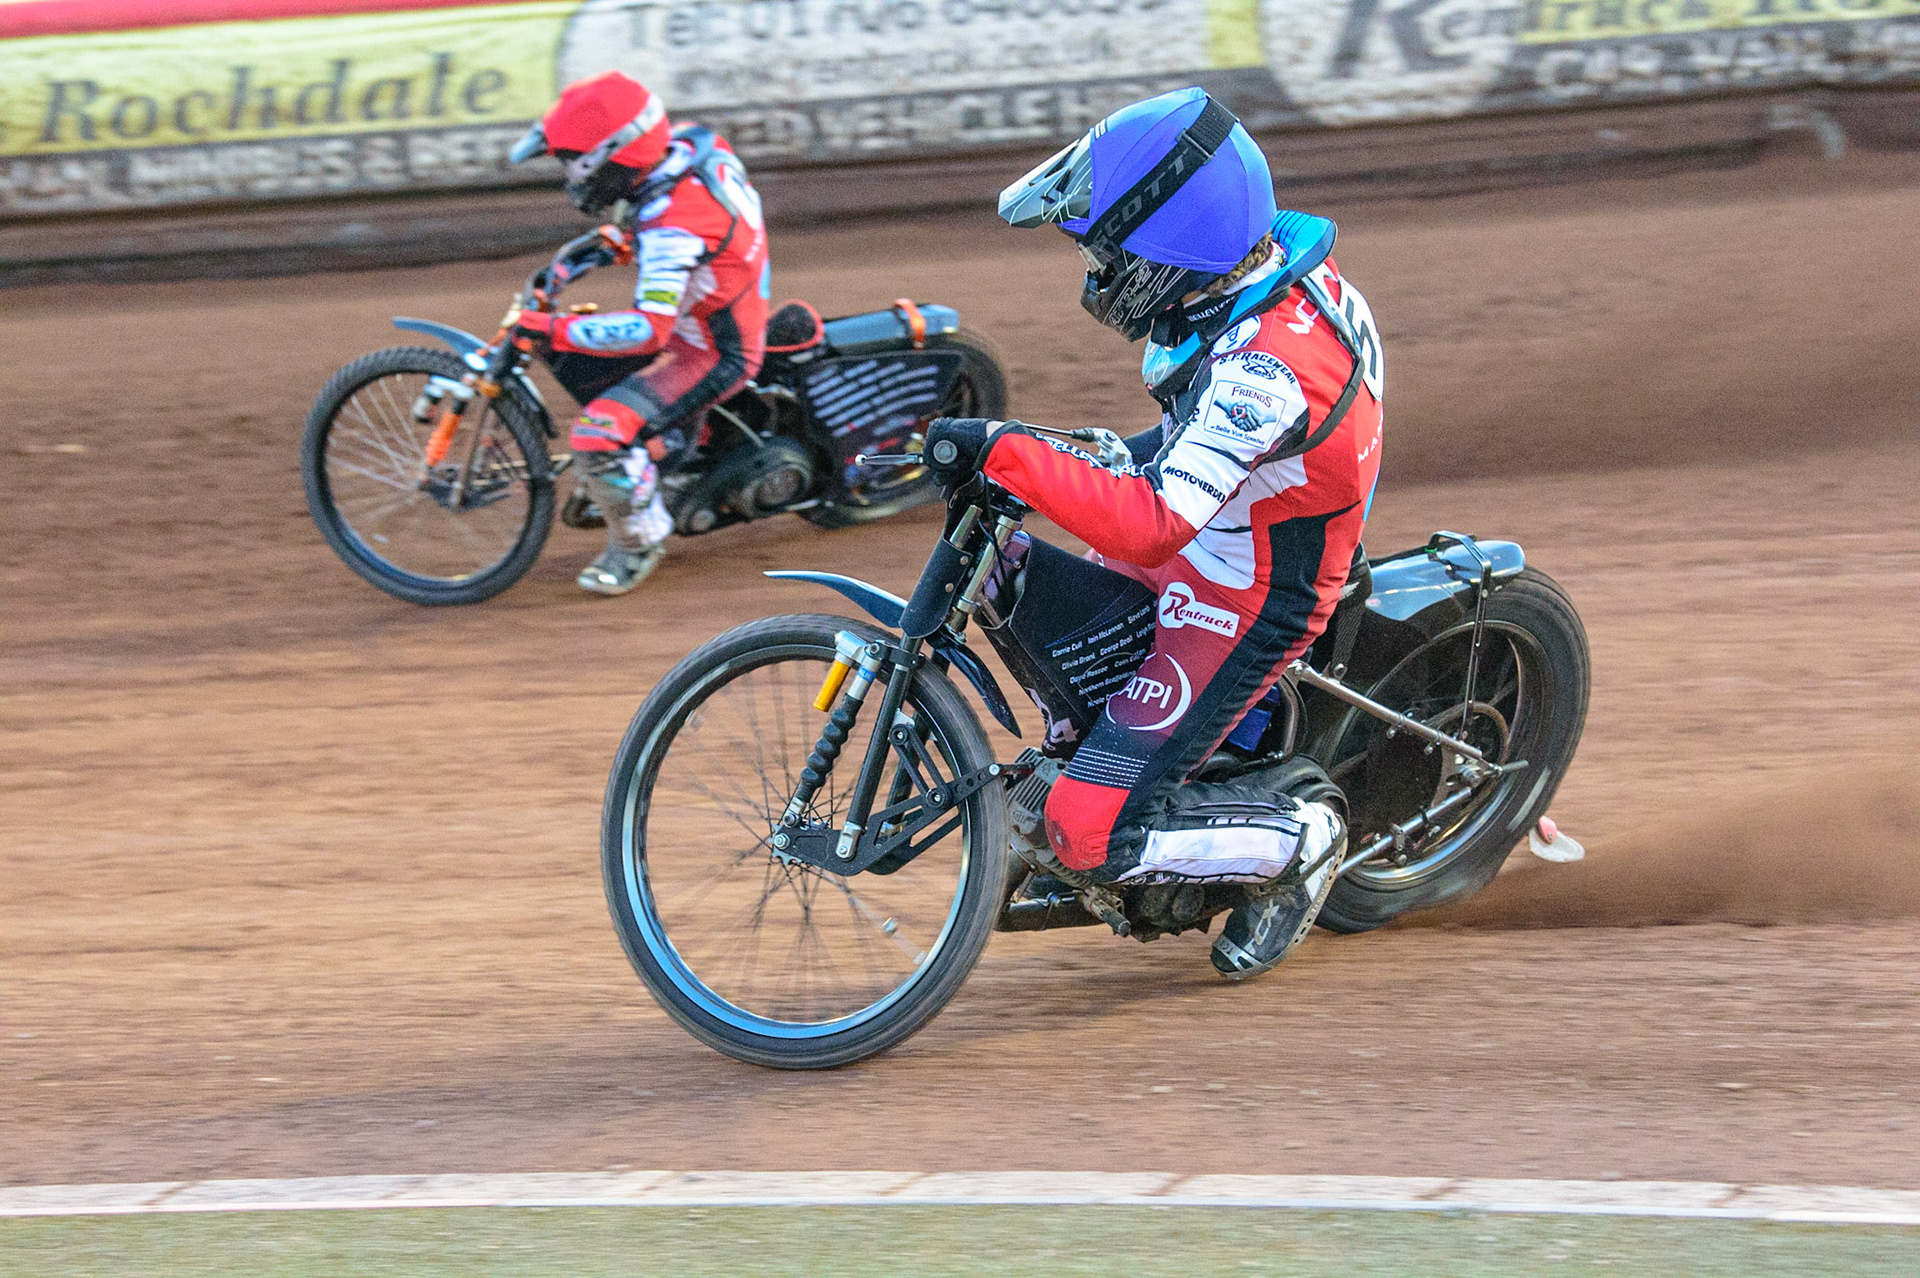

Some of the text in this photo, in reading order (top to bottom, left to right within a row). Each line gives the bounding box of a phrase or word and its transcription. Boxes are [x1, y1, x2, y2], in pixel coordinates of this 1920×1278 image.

[38, 51, 510, 144] Rochdale
[1094, 149, 1190, 251] SCOTT
[1231, 386, 1272, 408] FRIENDS
[1162, 590, 1234, 630] Rentruck
[1118, 676, 1173, 709] ATPI
